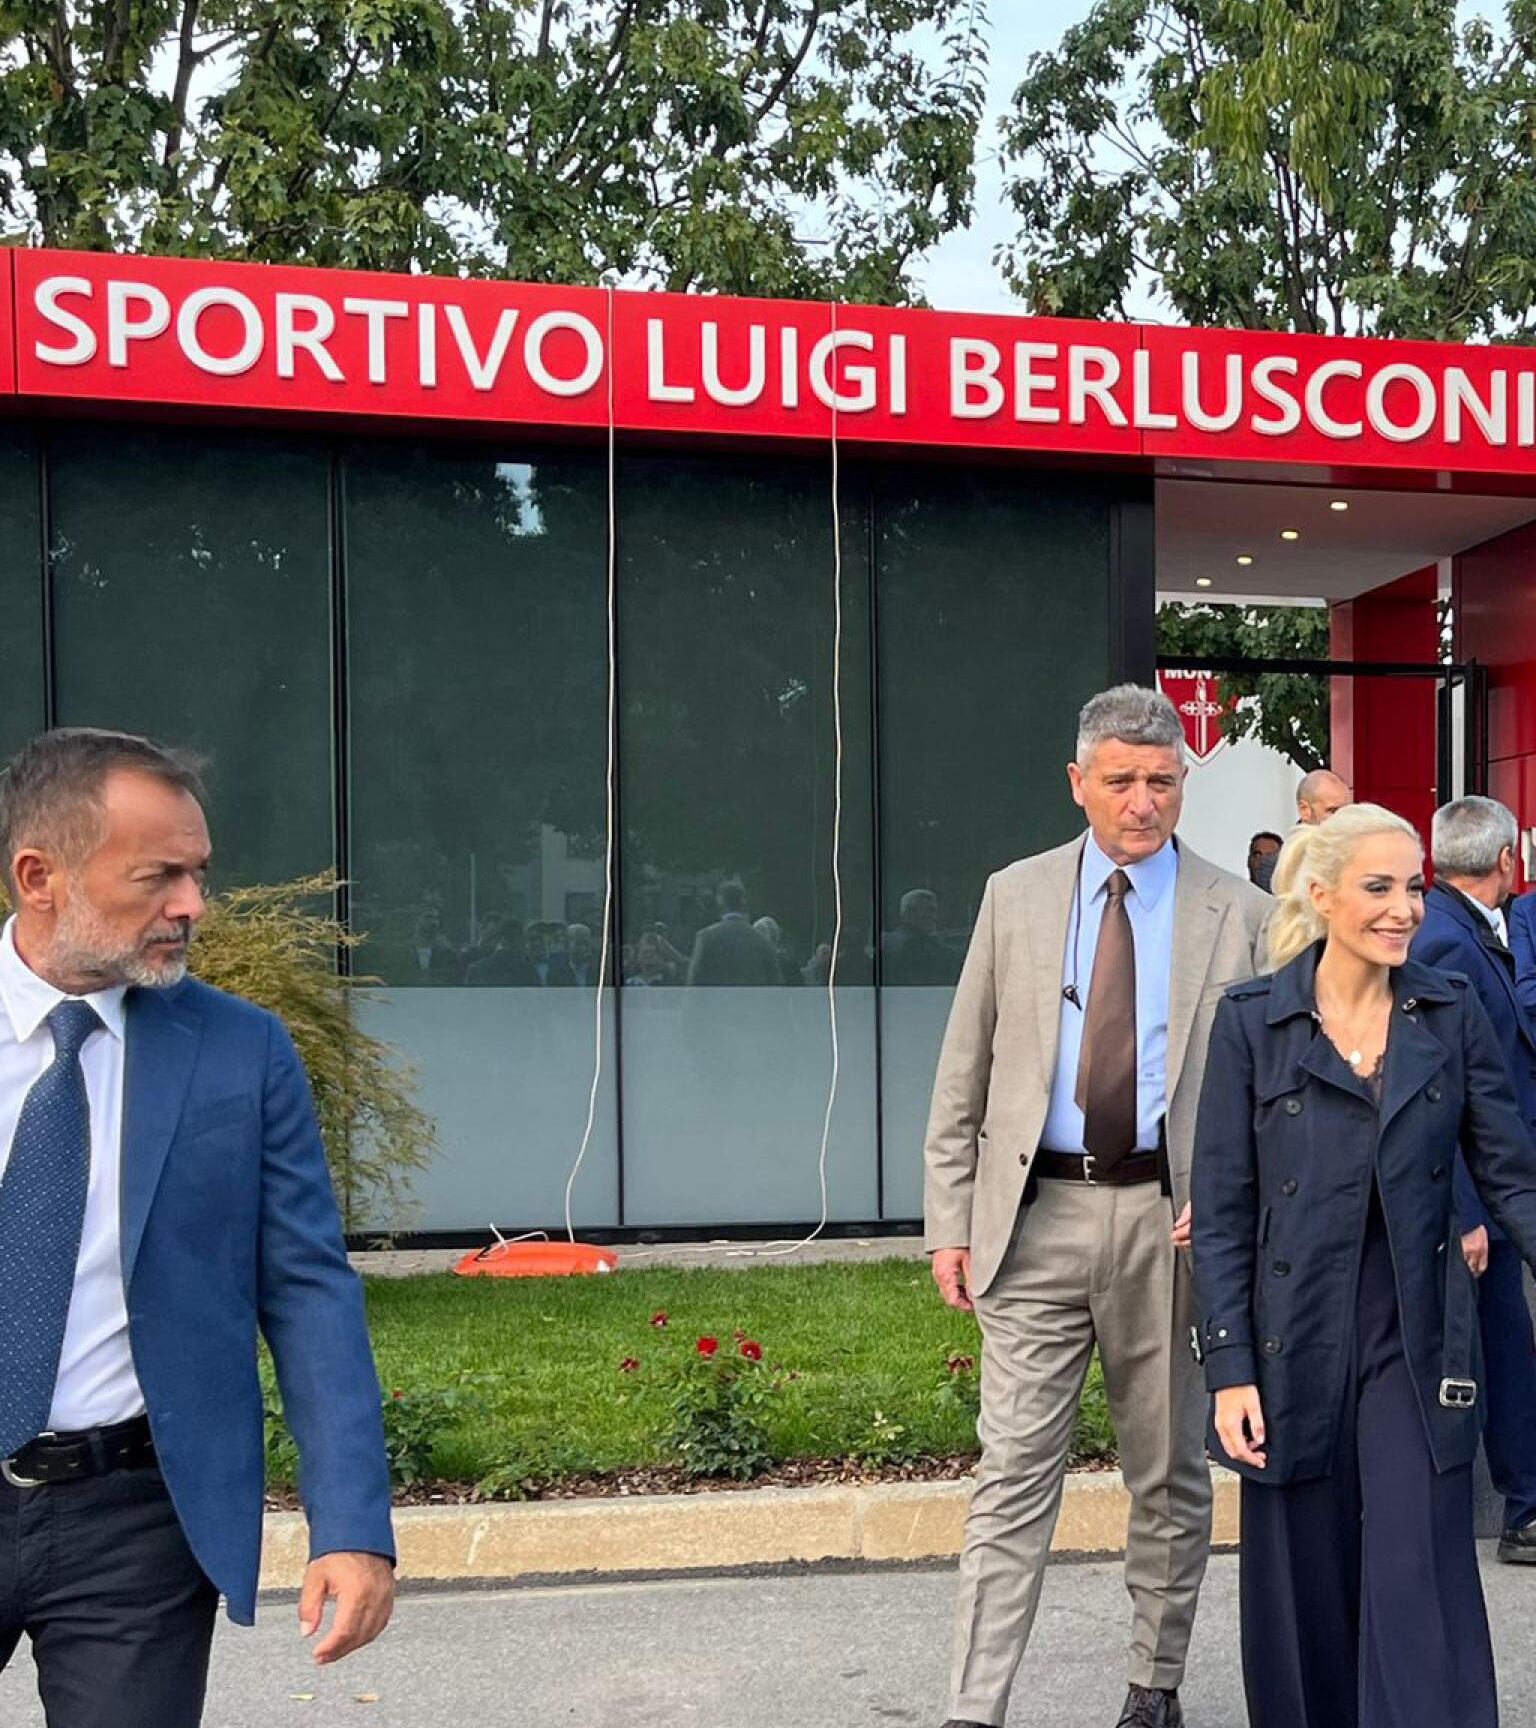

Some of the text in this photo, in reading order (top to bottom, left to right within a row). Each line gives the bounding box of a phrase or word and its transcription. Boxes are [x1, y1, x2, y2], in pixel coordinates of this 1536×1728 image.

[34, 276, 1535, 446] SPORTIVO LUIGI BERLUSCONI
